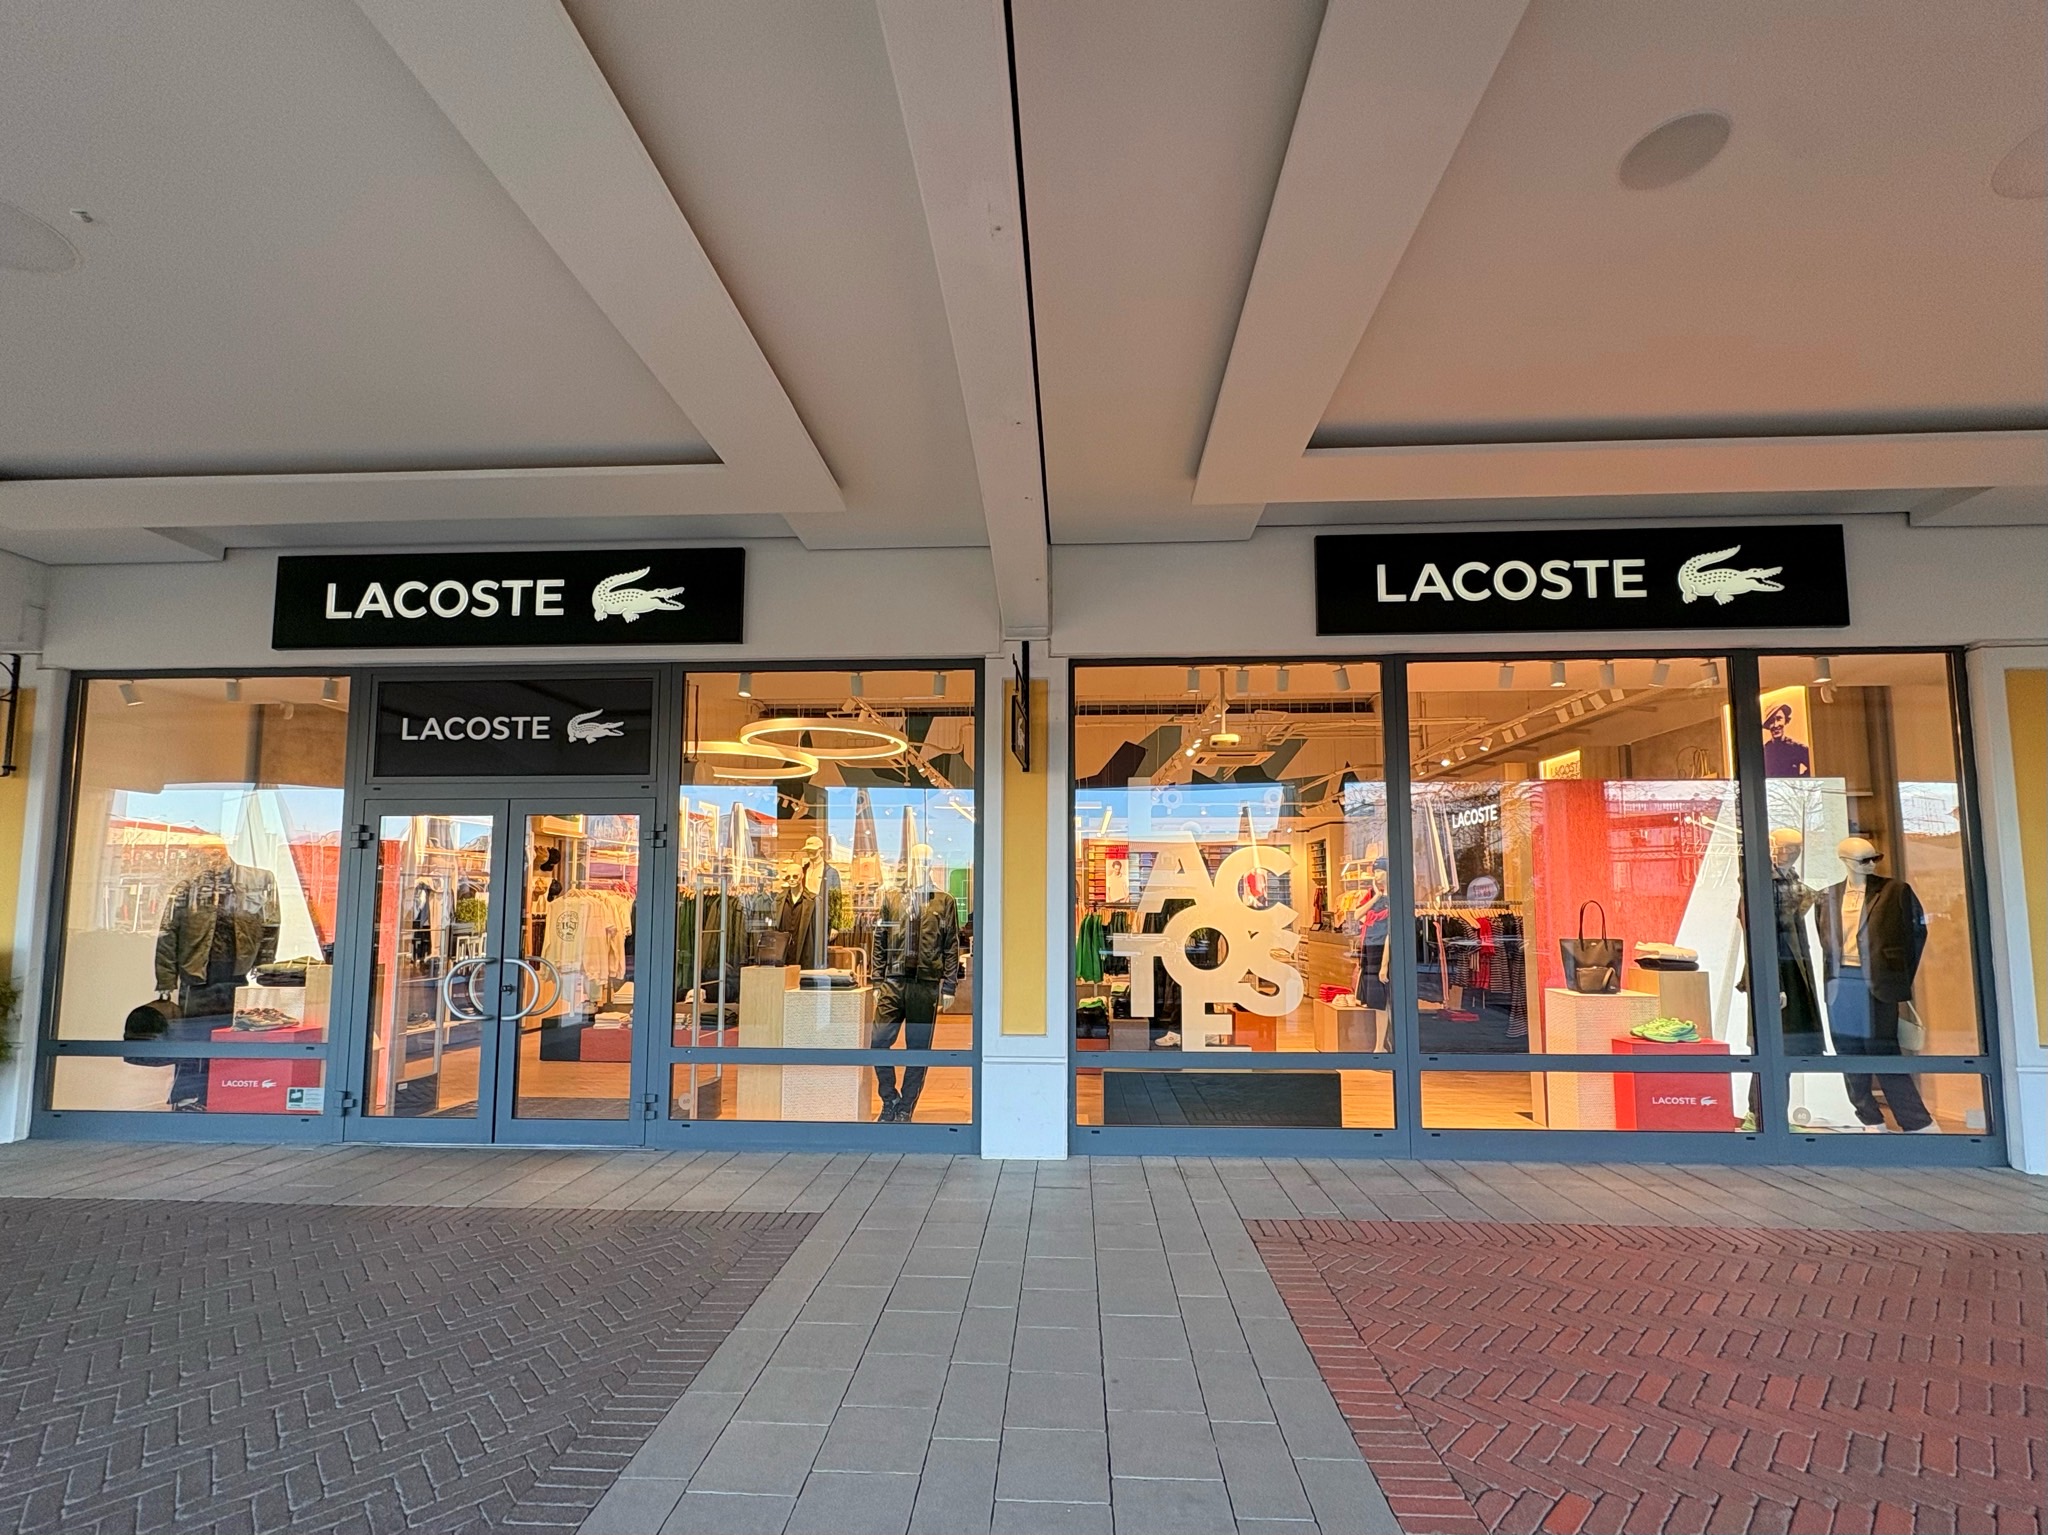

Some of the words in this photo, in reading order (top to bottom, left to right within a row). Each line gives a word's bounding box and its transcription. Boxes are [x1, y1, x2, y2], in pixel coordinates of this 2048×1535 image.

[1376, 558, 1648, 603] LACOSTE
[325, 578, 565, 620] LACOSTE
[401, 716, 551, 741] LACOSTE
[1453, 804, 1498, 829] LACOSTE
[1652, 1096, 1697, 1105] LACOSTE
